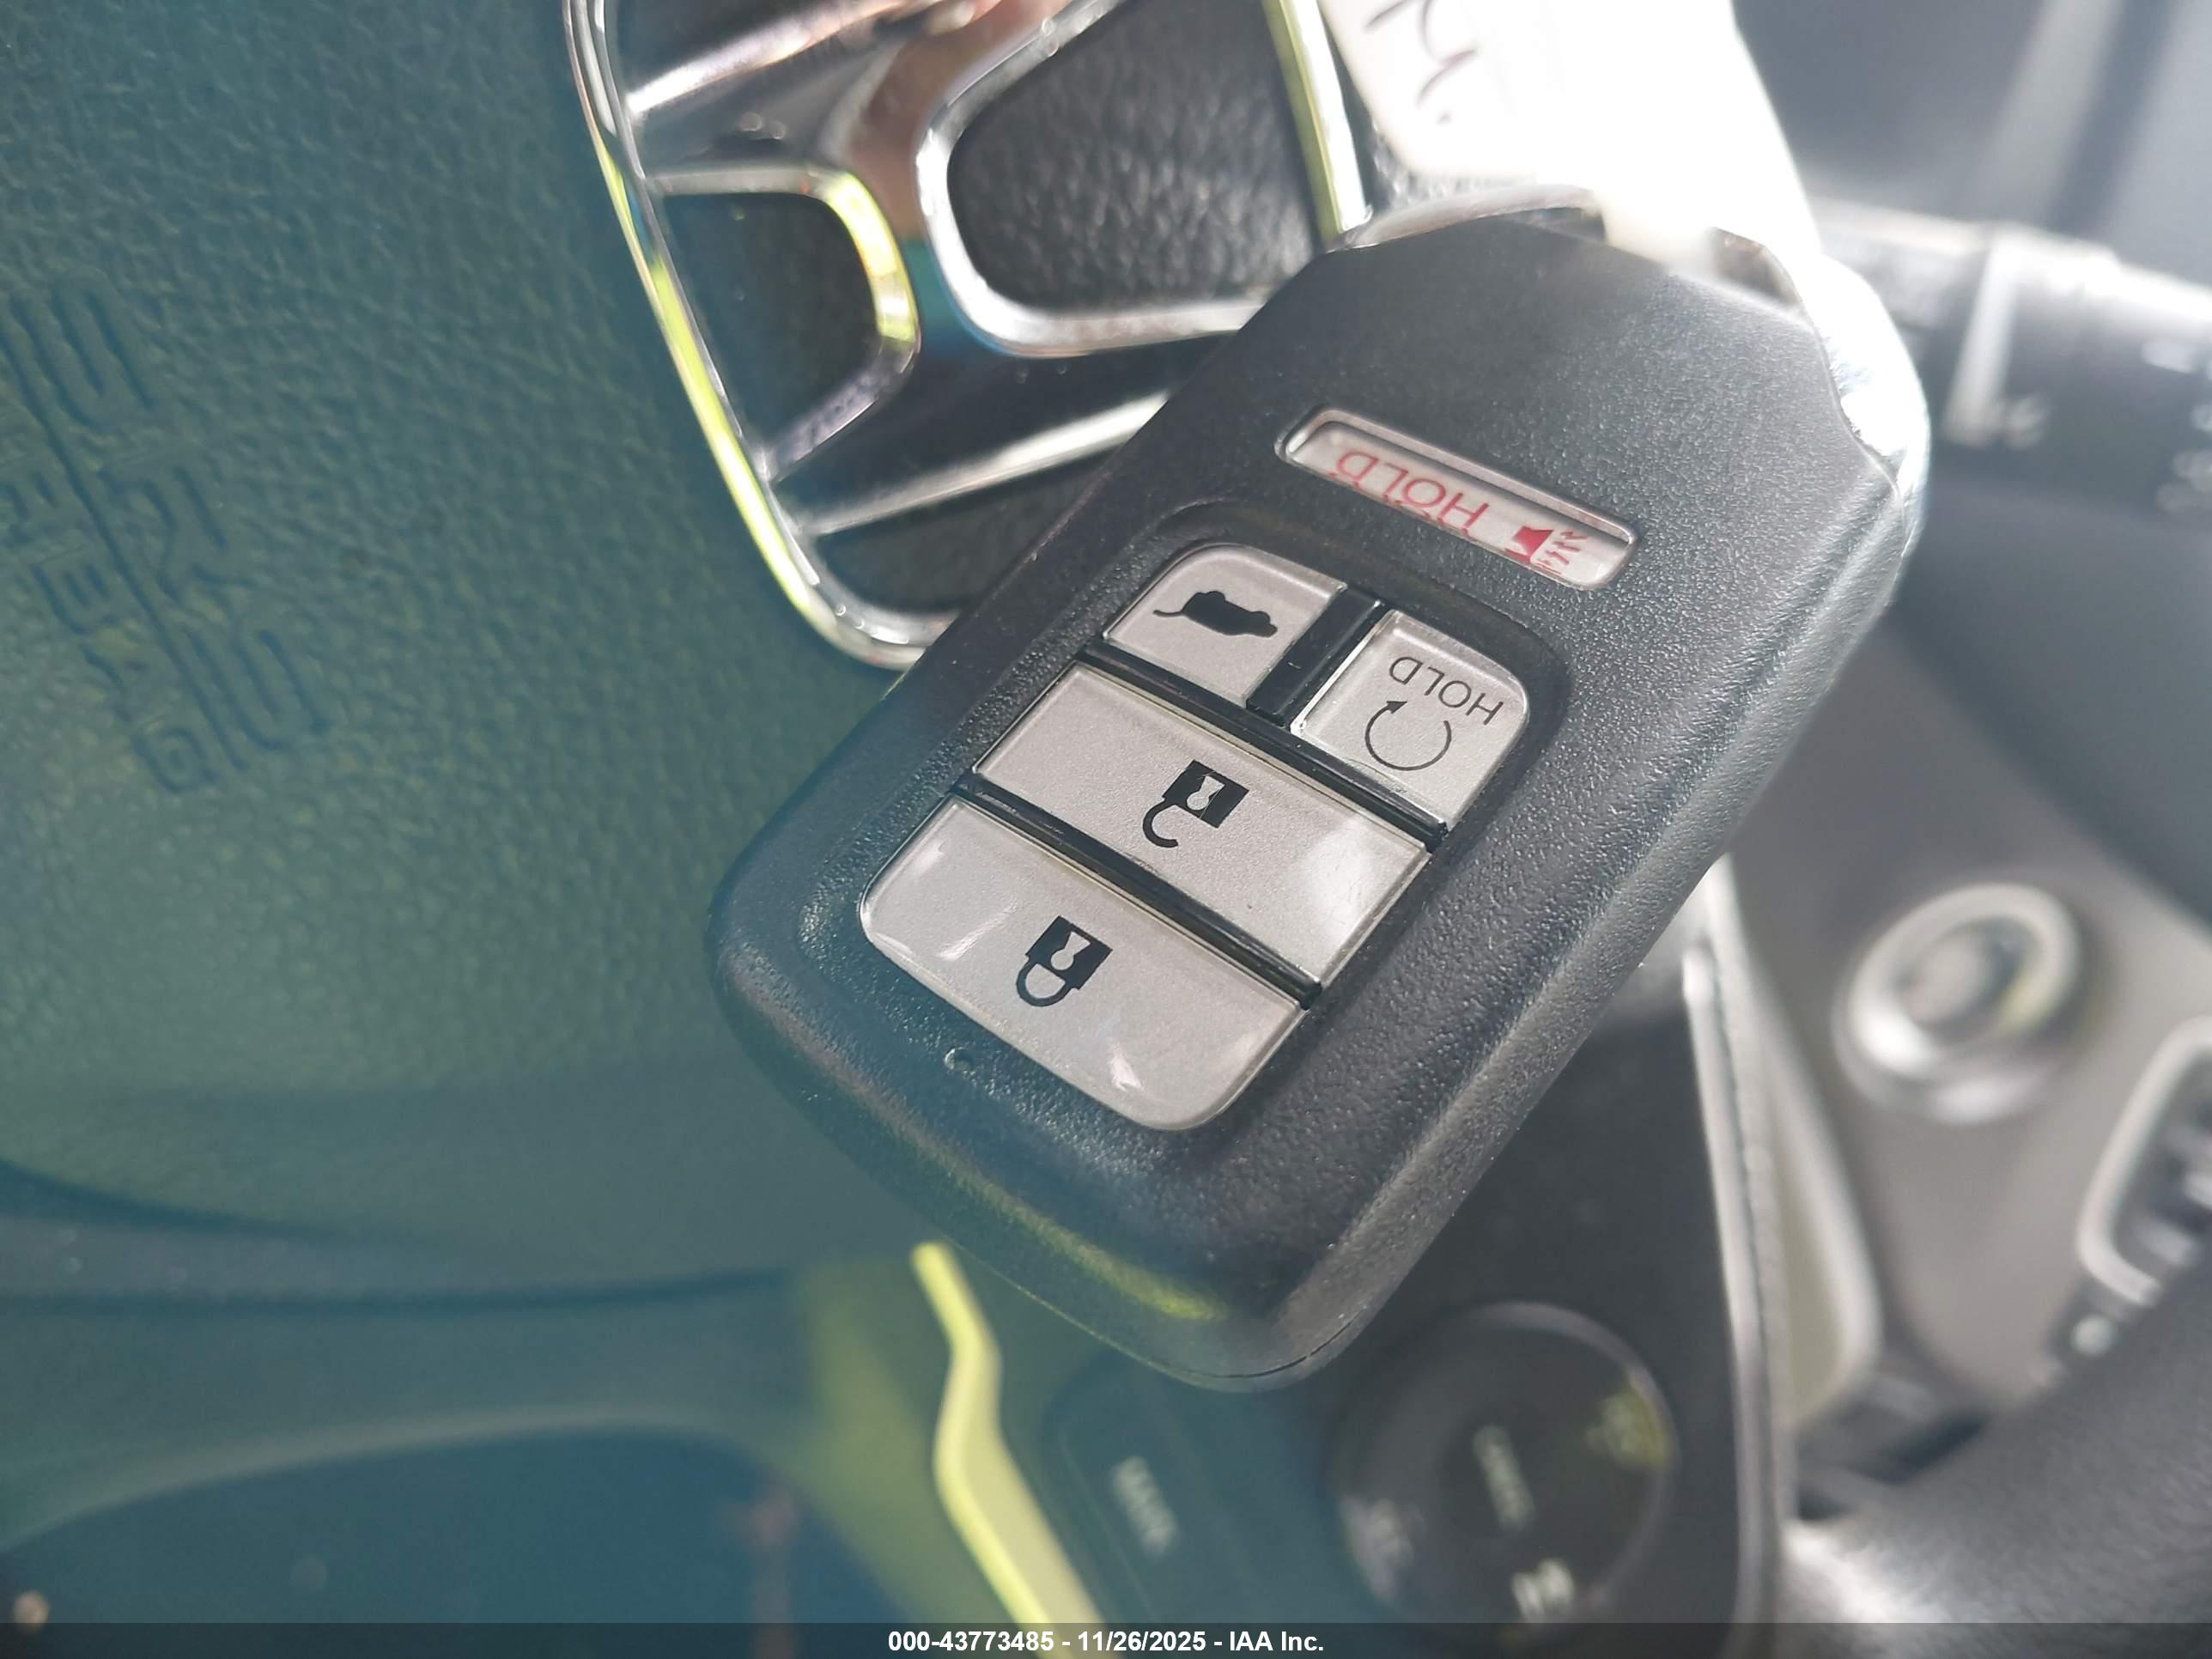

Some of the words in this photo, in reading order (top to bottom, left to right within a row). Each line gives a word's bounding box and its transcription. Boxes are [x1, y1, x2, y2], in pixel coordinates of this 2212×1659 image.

[7, 279, 331, 752] SRS
[1334, 450, 1490, 537] HOLD
[1389, 656, 1504, 726] HOLD
